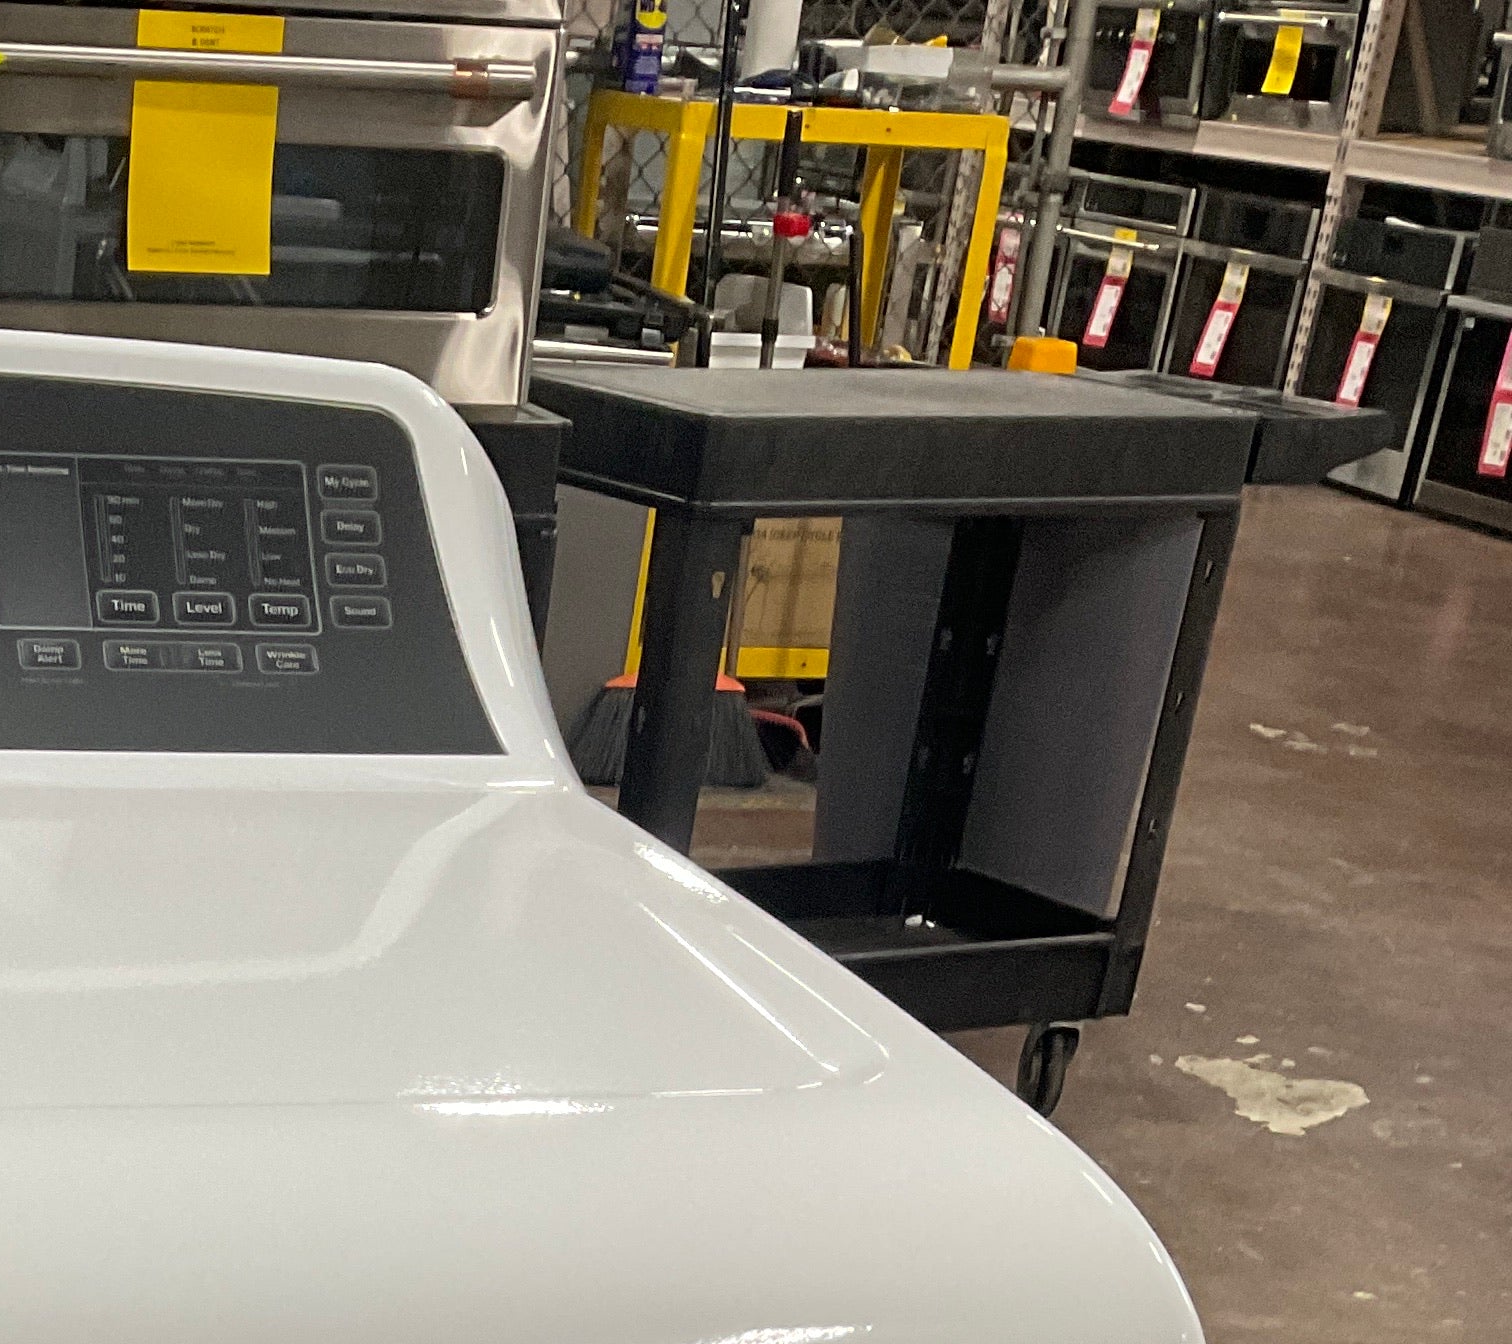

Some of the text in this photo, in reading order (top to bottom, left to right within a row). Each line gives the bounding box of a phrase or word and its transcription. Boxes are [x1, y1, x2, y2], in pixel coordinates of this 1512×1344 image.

[336, 521, 364, 533] Delay
[111, 599, 146, 613] Time
[187, 601, 223, 614] Level
[261, 603, 299, 617] Temp
[344, 606, 376, 616] Sound
[37, 654, 63, 665] Alert
[122, 655, 149, 665] Time
[199, 656, 224, 667] Time
